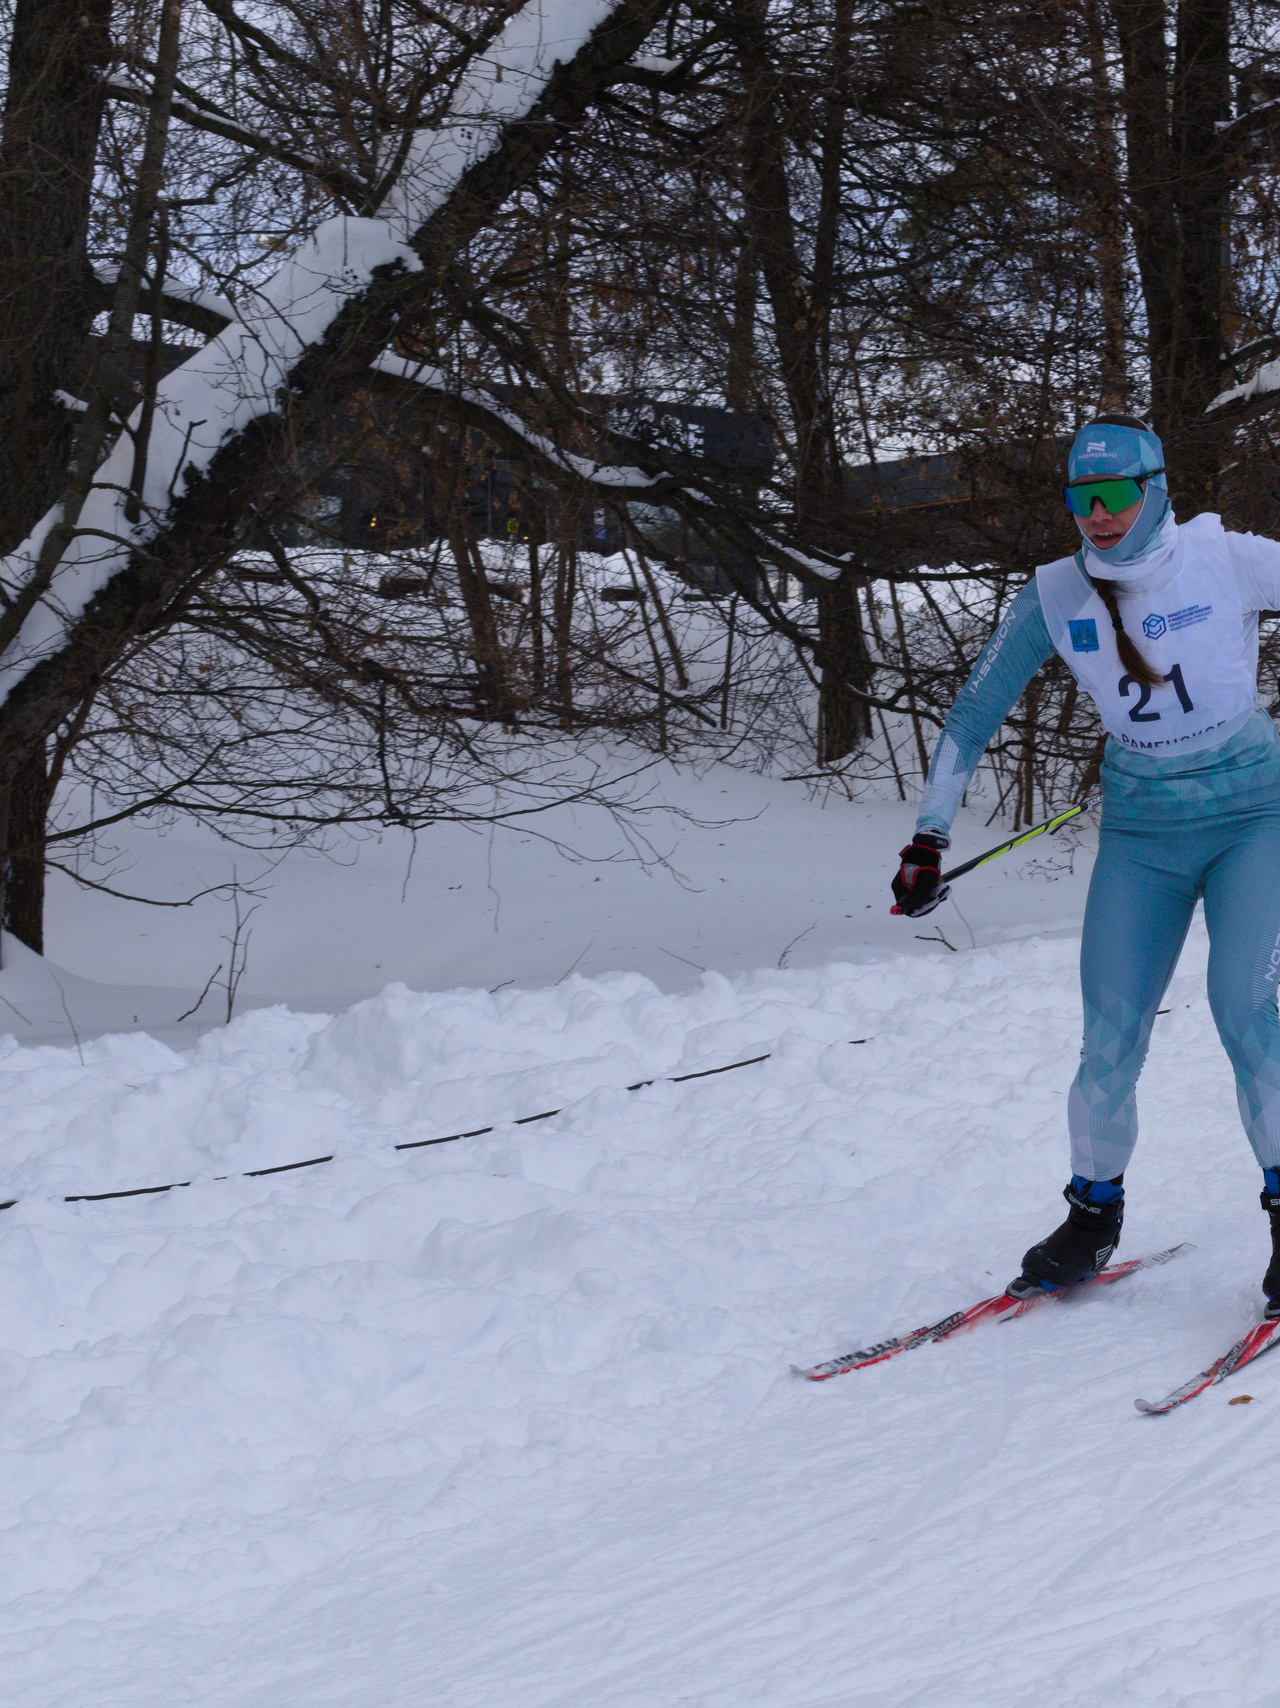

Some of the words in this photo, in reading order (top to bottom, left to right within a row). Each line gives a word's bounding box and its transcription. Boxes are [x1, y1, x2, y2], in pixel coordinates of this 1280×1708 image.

[1078, 452, 1117, 460] NORDSKI
[969, 610, 1016, 694] NORDSKI
[1118, 663, 1194, 722] 21
[1068, 1193, 1101, 1214] SPINE
